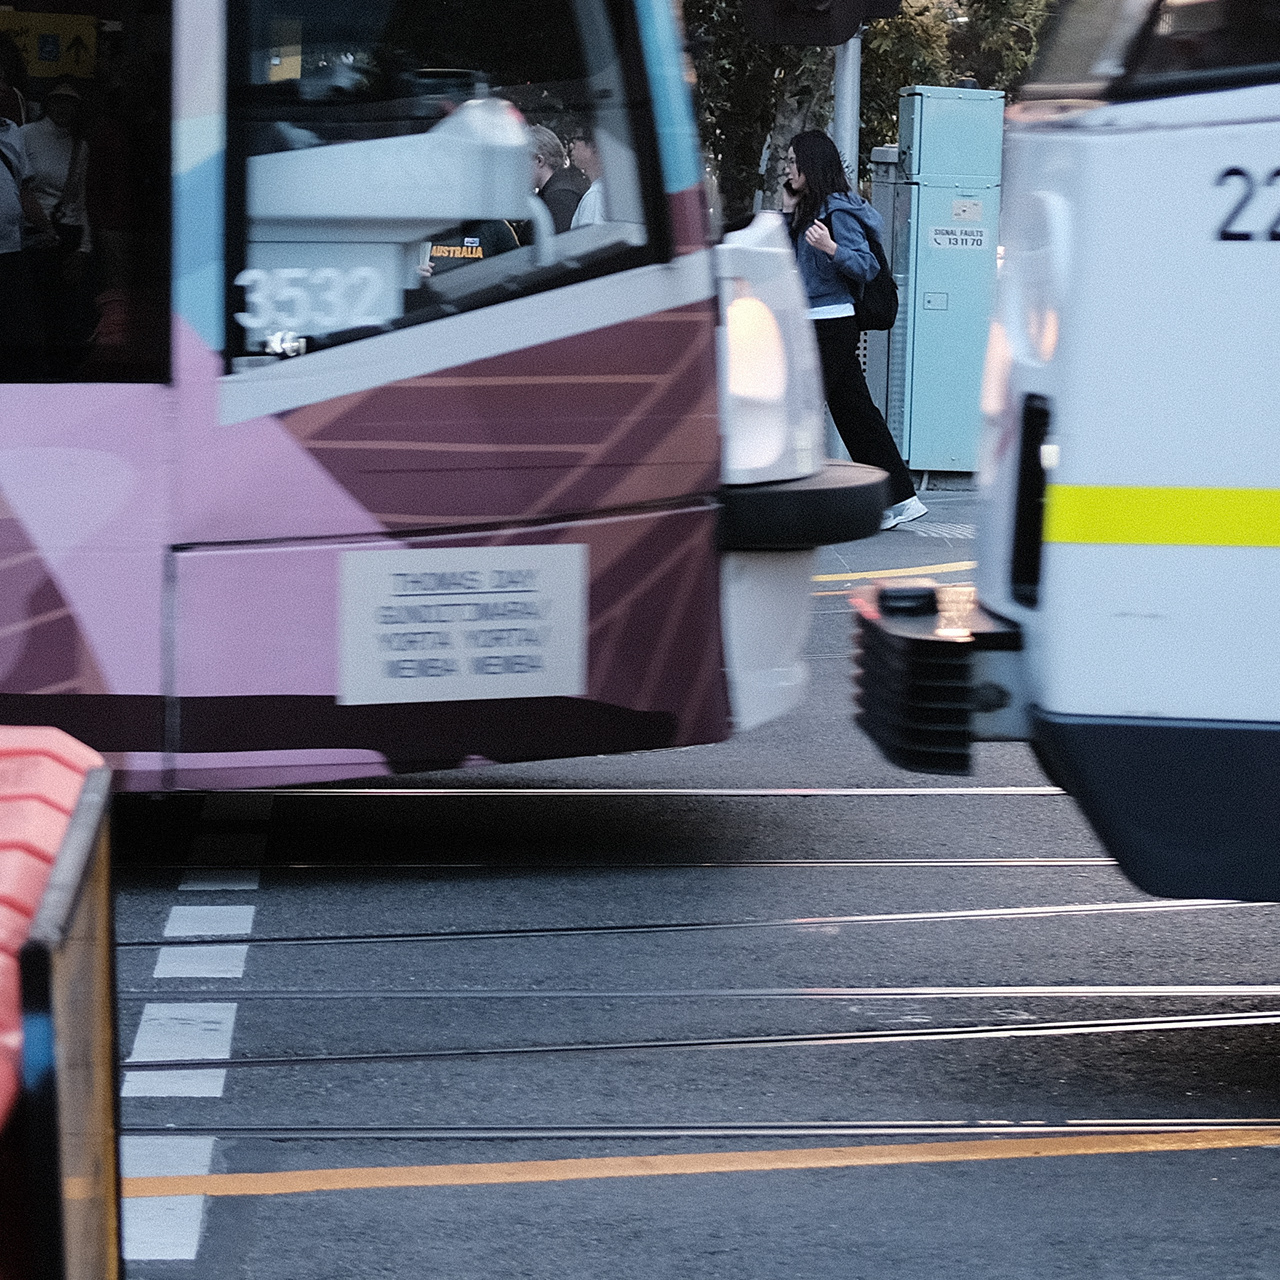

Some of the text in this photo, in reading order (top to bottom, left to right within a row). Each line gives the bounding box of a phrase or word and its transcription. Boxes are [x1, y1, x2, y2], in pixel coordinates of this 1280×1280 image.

[934, 228, 984, 237] SIGNAL FAULTS
[948, 237, 983, 246] 13 11 70
[431, 245, 484, 259] AUSTRALIA
[233, 267, 384, 329] 3532
[391, 568, 539, 592] THOMAS DAY
